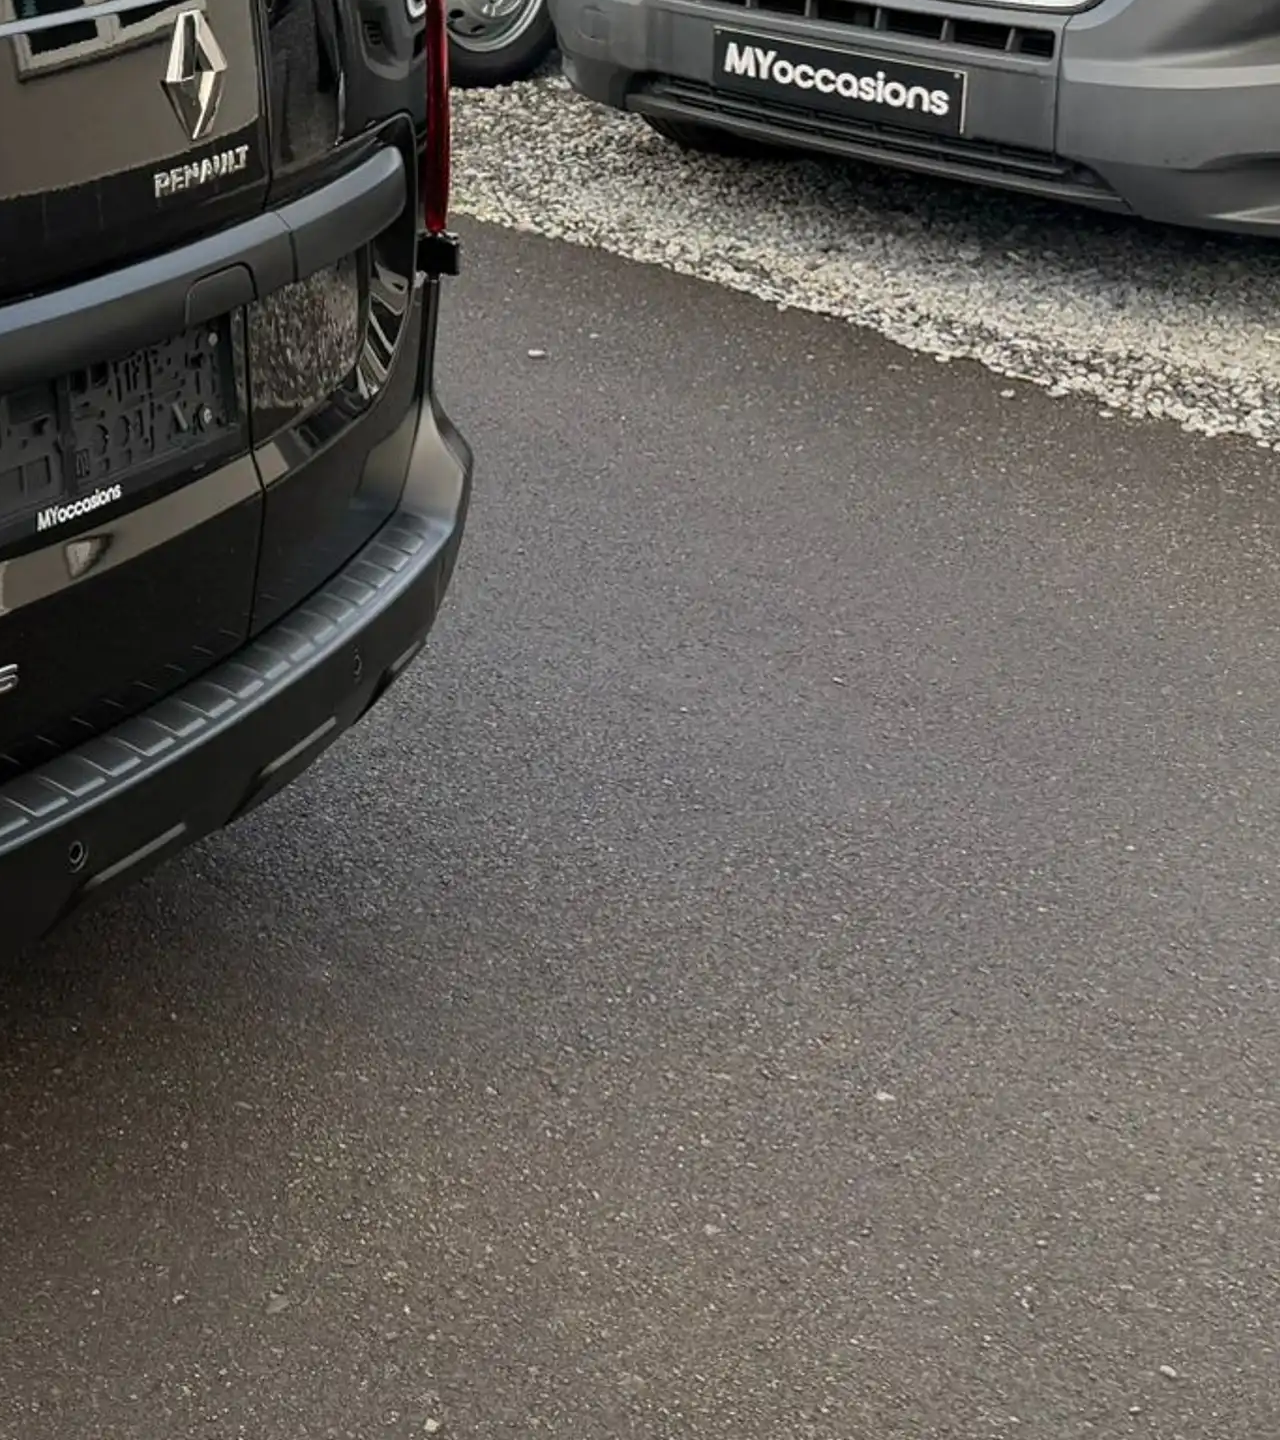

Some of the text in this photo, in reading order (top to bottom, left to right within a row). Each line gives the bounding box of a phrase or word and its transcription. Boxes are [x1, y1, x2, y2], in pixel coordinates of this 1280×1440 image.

[724, 42, 950, 116] MYoccasions
[154, 145, 249, 198] RENAULT
[37, 484, 122, 532] MYoccasions
